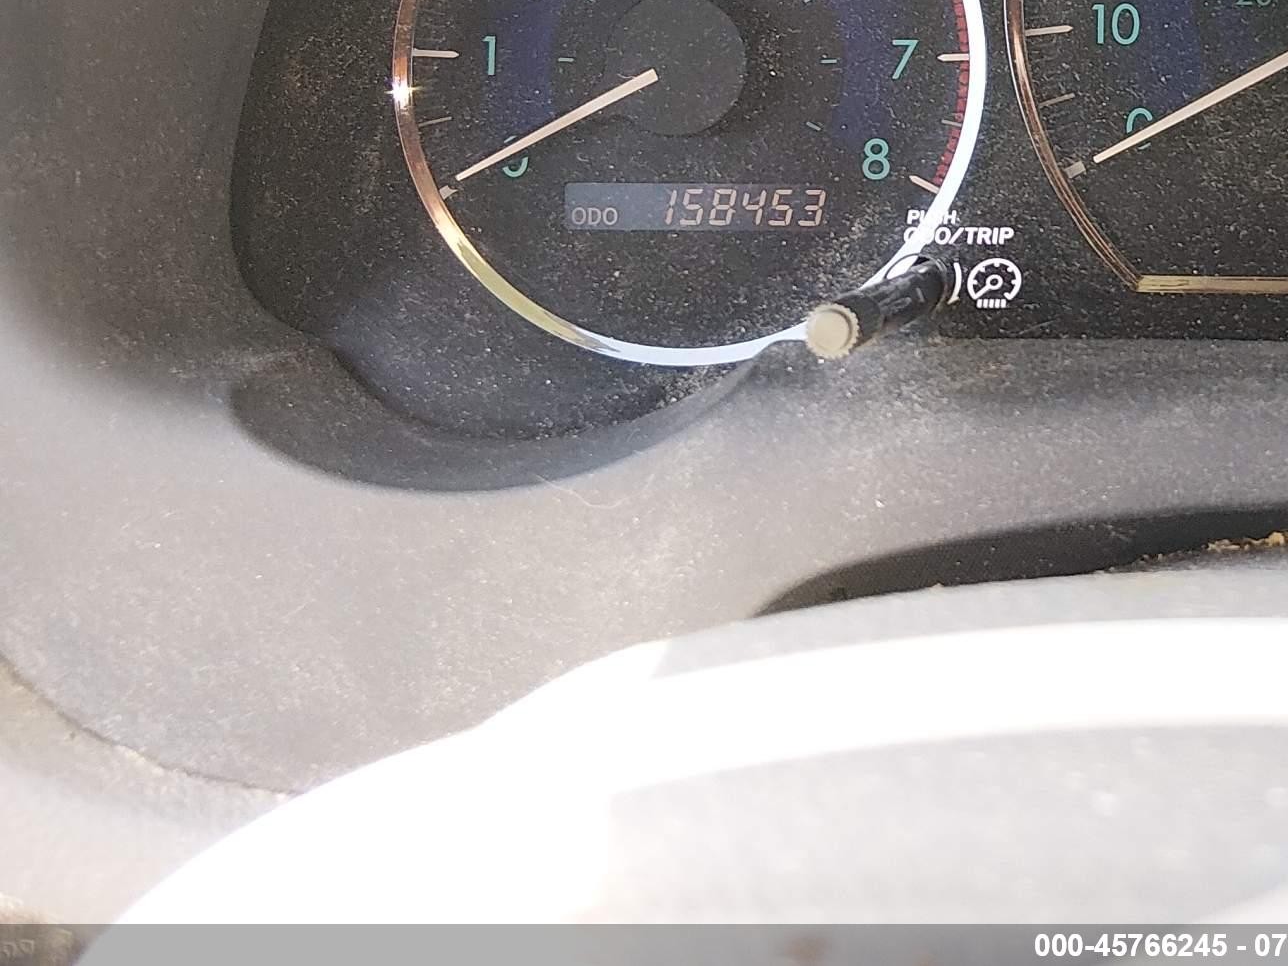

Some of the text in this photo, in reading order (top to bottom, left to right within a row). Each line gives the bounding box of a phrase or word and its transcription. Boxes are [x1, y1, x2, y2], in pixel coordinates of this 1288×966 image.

[1094, 4, 1140, 46] 10
[483, 36, 496, 75] 1
[893, 40, 919, 79] 7
[863, 139, 889, 179] 8
[571, 189, 826, 227] ODO 158453
